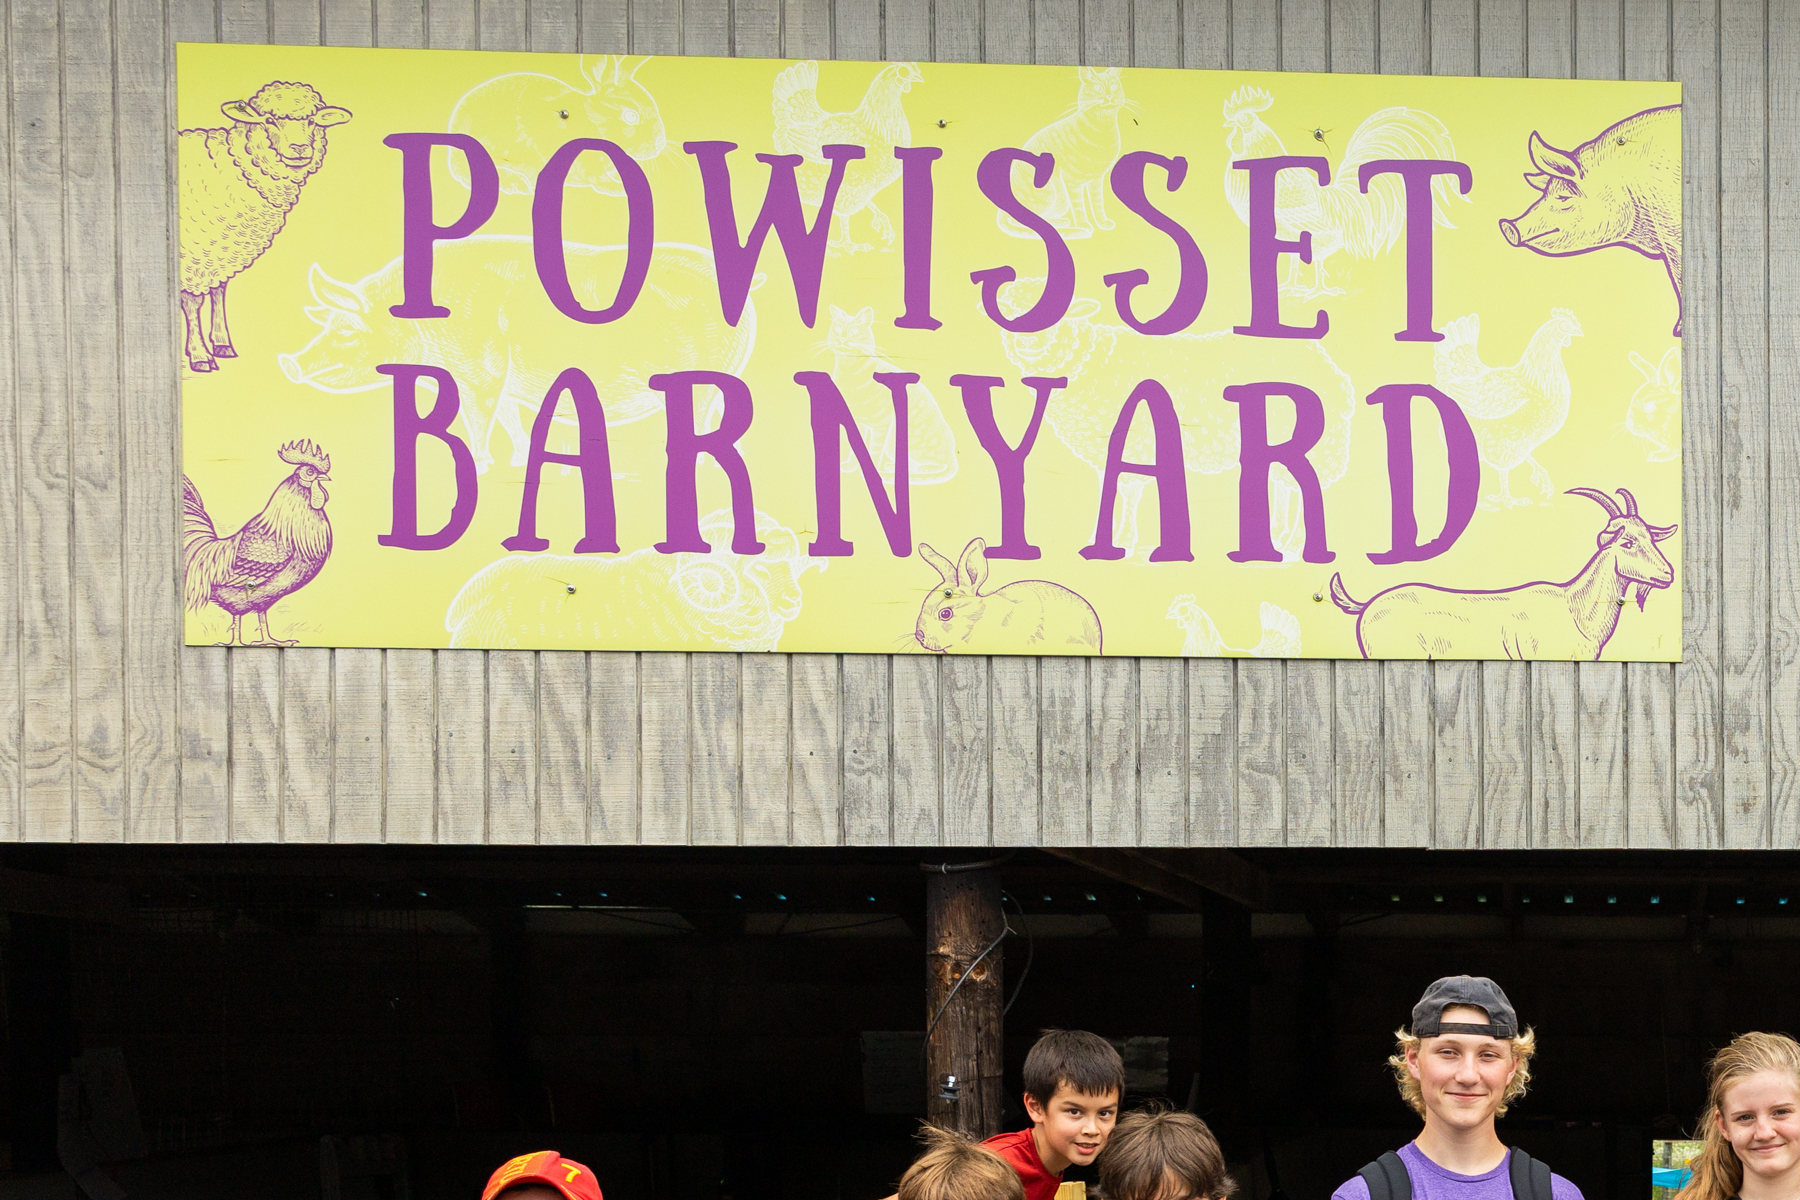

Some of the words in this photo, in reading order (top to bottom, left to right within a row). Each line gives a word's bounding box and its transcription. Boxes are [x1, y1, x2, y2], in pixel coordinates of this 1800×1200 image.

[384, 134, 1472, 342] POWISSET
[377, 364, 1480, 565] BARNYARD
[561, 1163, 581, 1183] 7
